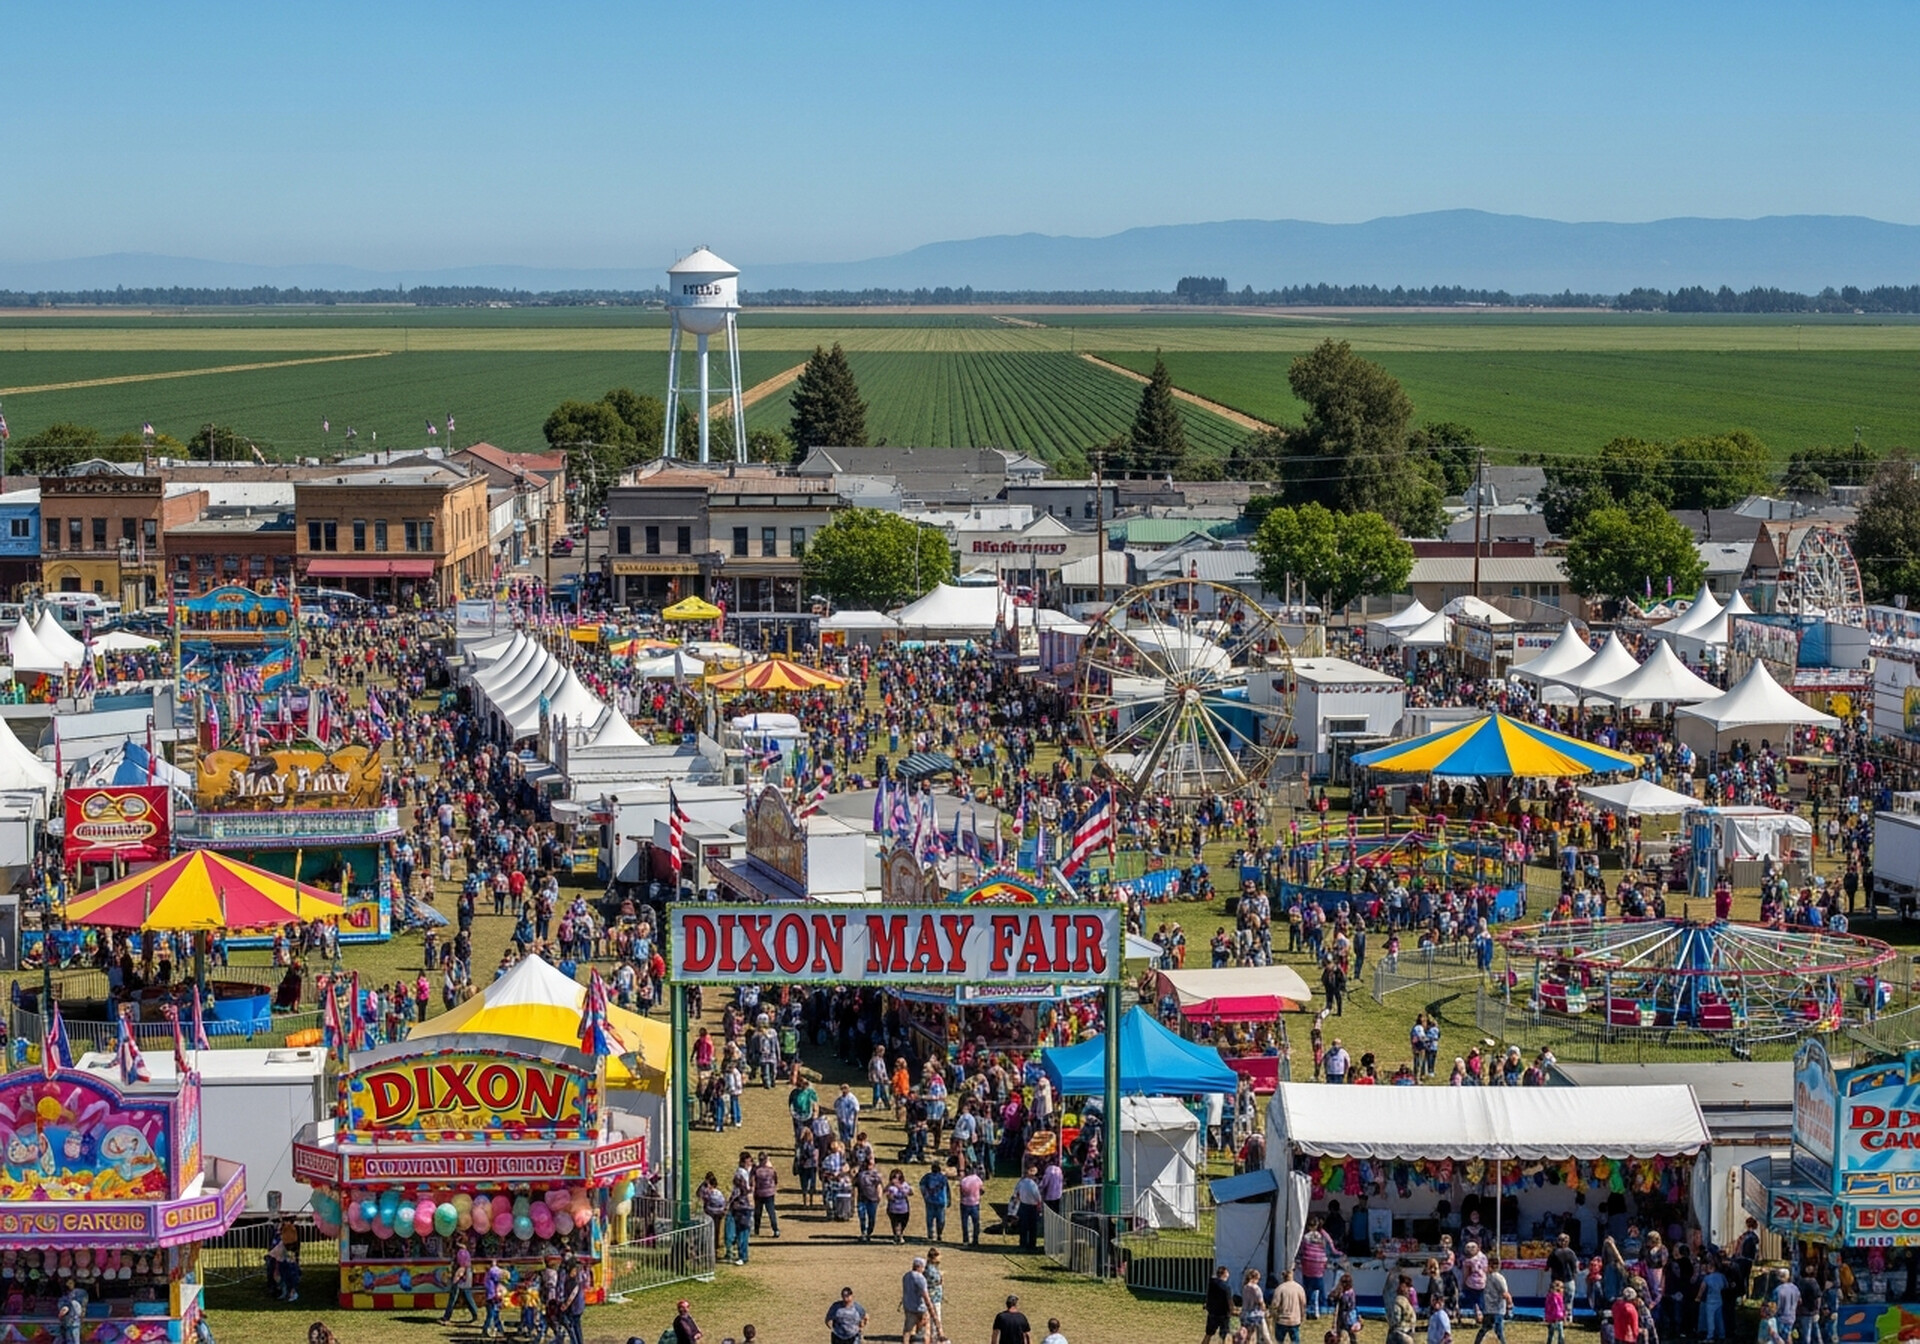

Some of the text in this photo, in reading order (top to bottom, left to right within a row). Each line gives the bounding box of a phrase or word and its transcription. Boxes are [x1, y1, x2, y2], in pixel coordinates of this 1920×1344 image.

[682, 914, 1107, 974] DIXON MAY FAIR
[365, 1061, 570, 1124] DIXON
